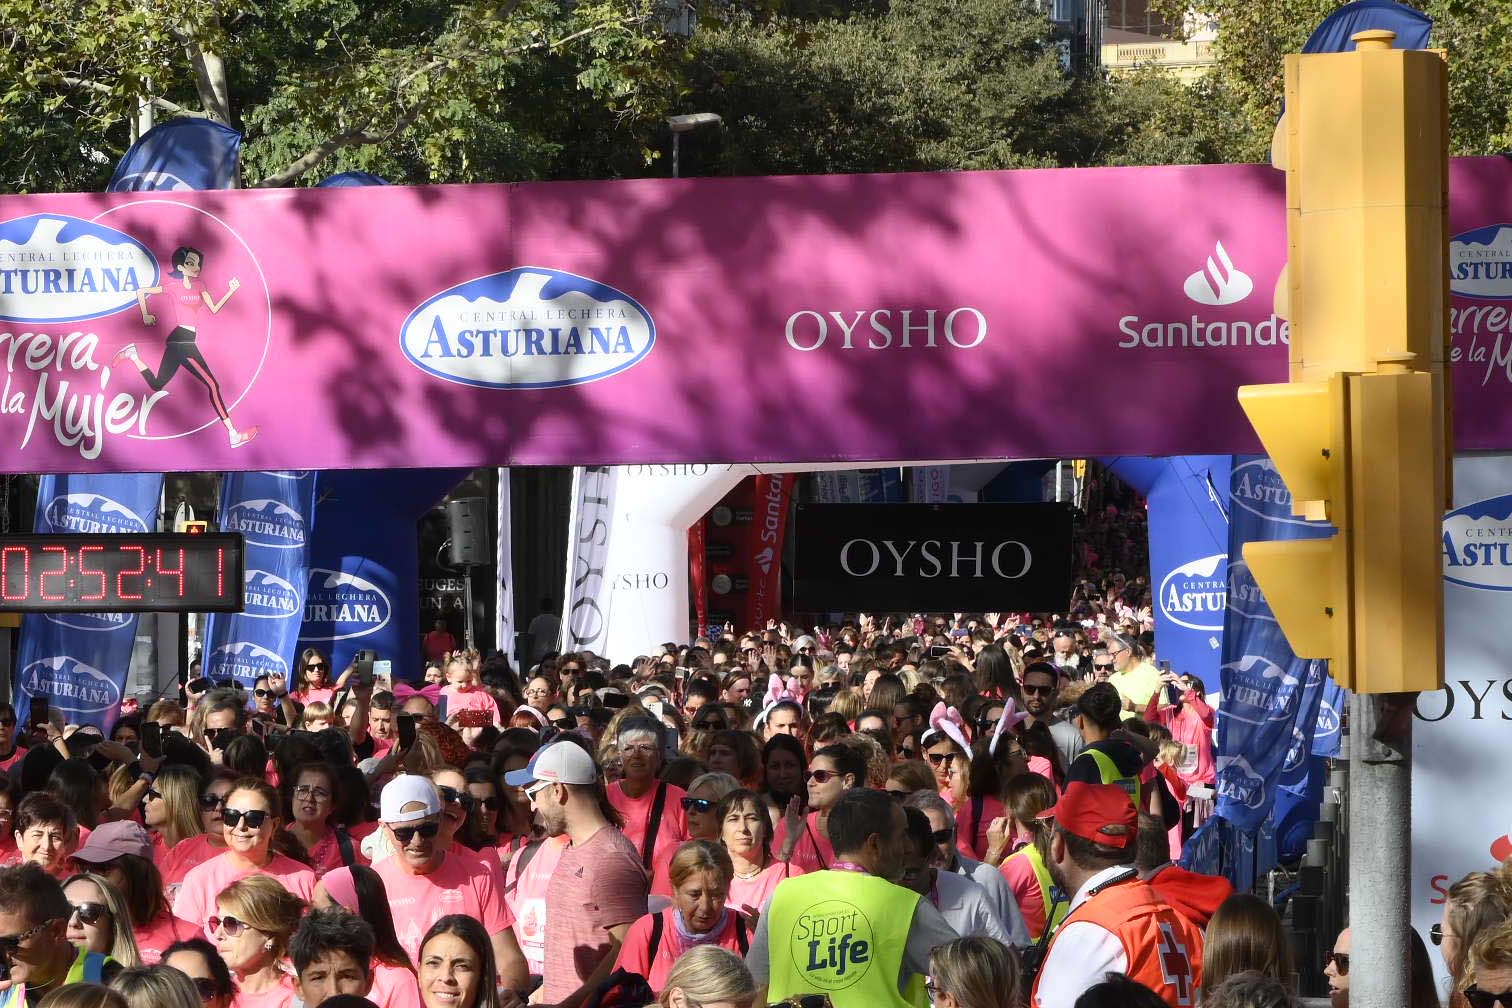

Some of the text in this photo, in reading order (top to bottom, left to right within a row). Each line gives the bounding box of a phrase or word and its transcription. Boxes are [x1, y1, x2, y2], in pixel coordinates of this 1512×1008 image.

[63, 250, 136, 263] LECHERA
[459, 307, 626, 323] CENTRAL LECHERA
[785, 307, 988, 351] OYSHO
[1118, 314, 1289, 349] Santande
[421, 314, 635, 358] ASTURIANA
[0, 374, 26, 414] la
[21, 367, 170, 459] Mujer
[228, 511, 306, 542] ASTURIANA
[1, 546, 225, 600] 02:52:41
[570, 466, 610, 645] OYSH
[839, 538, 1034, 581] OYSHO
[1183, 581, 1226, 590] CENTRA
[26, 669, 110, 705] ASTURIANA
[797, 910, 858, 941] Sport
[806, 934, 869, 975] Life
